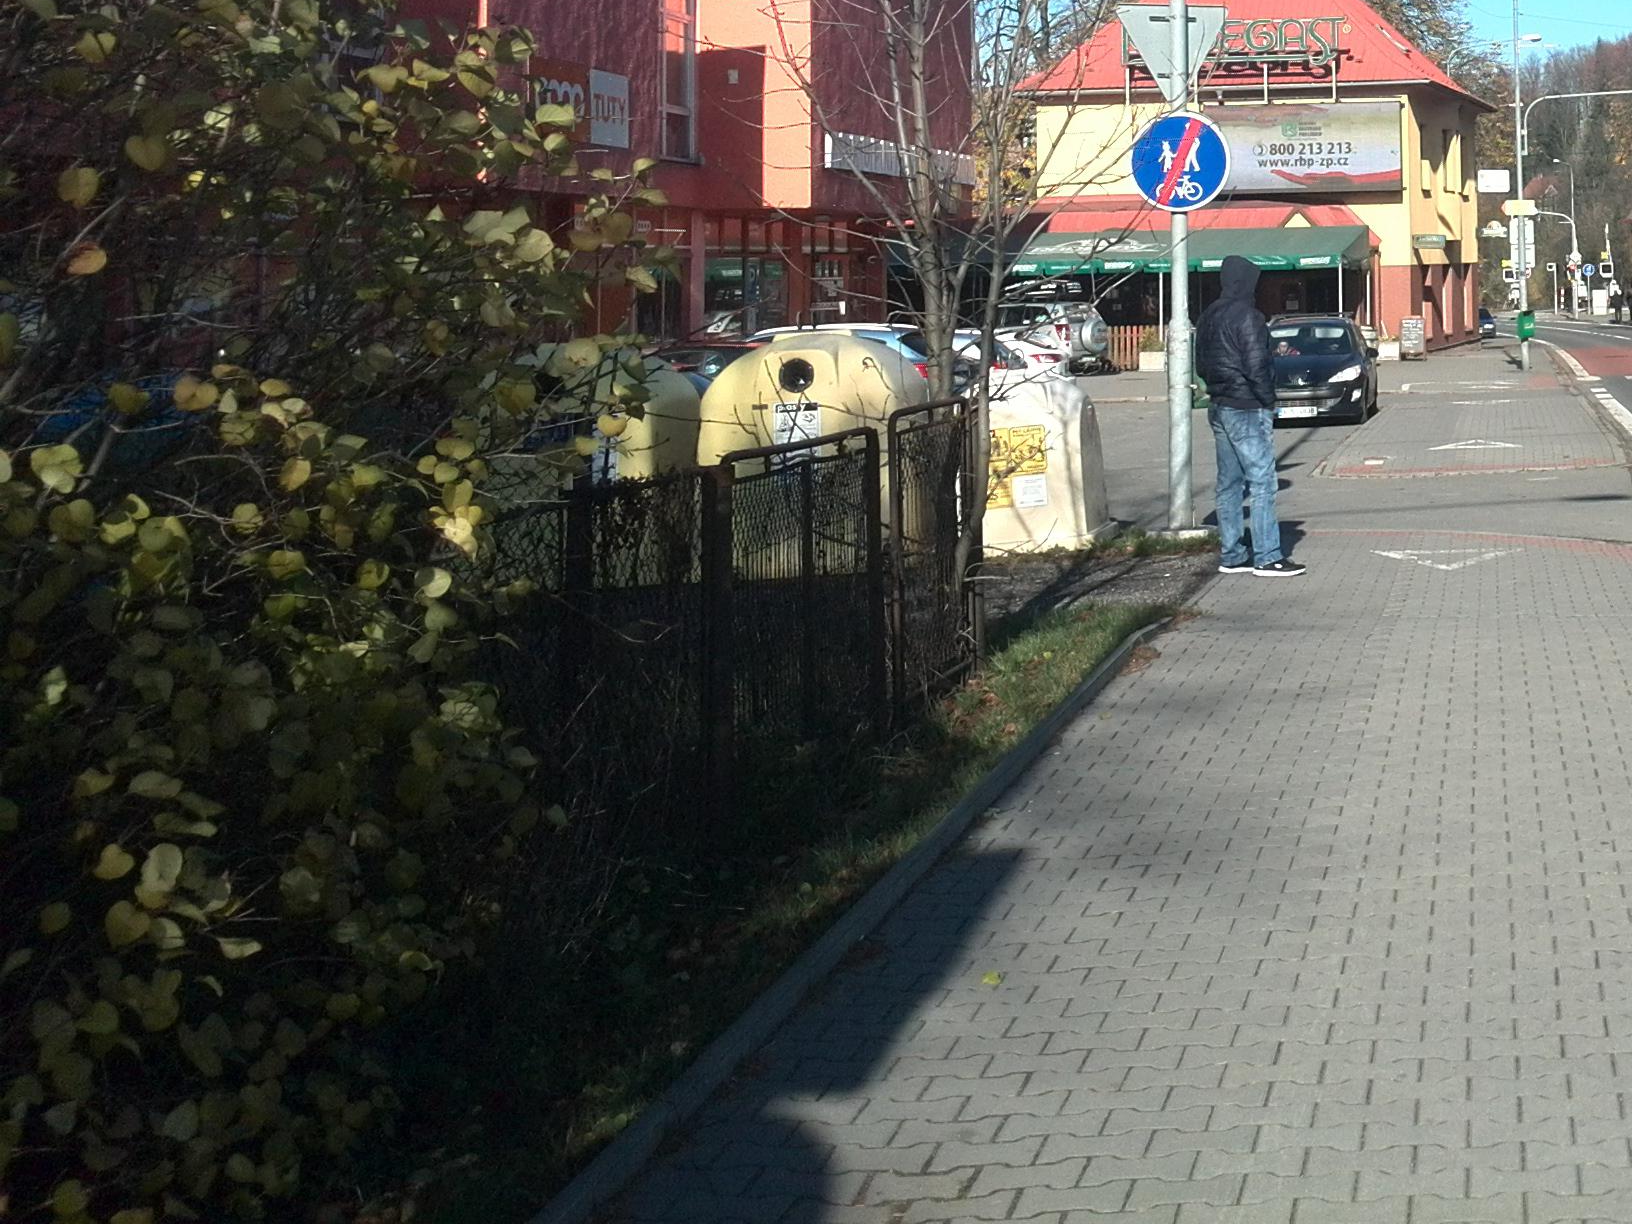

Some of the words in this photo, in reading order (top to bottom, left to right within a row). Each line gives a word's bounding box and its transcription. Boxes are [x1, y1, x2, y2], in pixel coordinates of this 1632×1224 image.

[1122, 17, 1347, 66] EGAST
[593, 93, 626, 126] TUTY
[1269, 143, 1295, 156] 800
[1298, 142, 1323, 155] 213
[1327, 141, 1352, 154] 213
[1257, 155, 1349, 169] www.rbp-zp.cz
